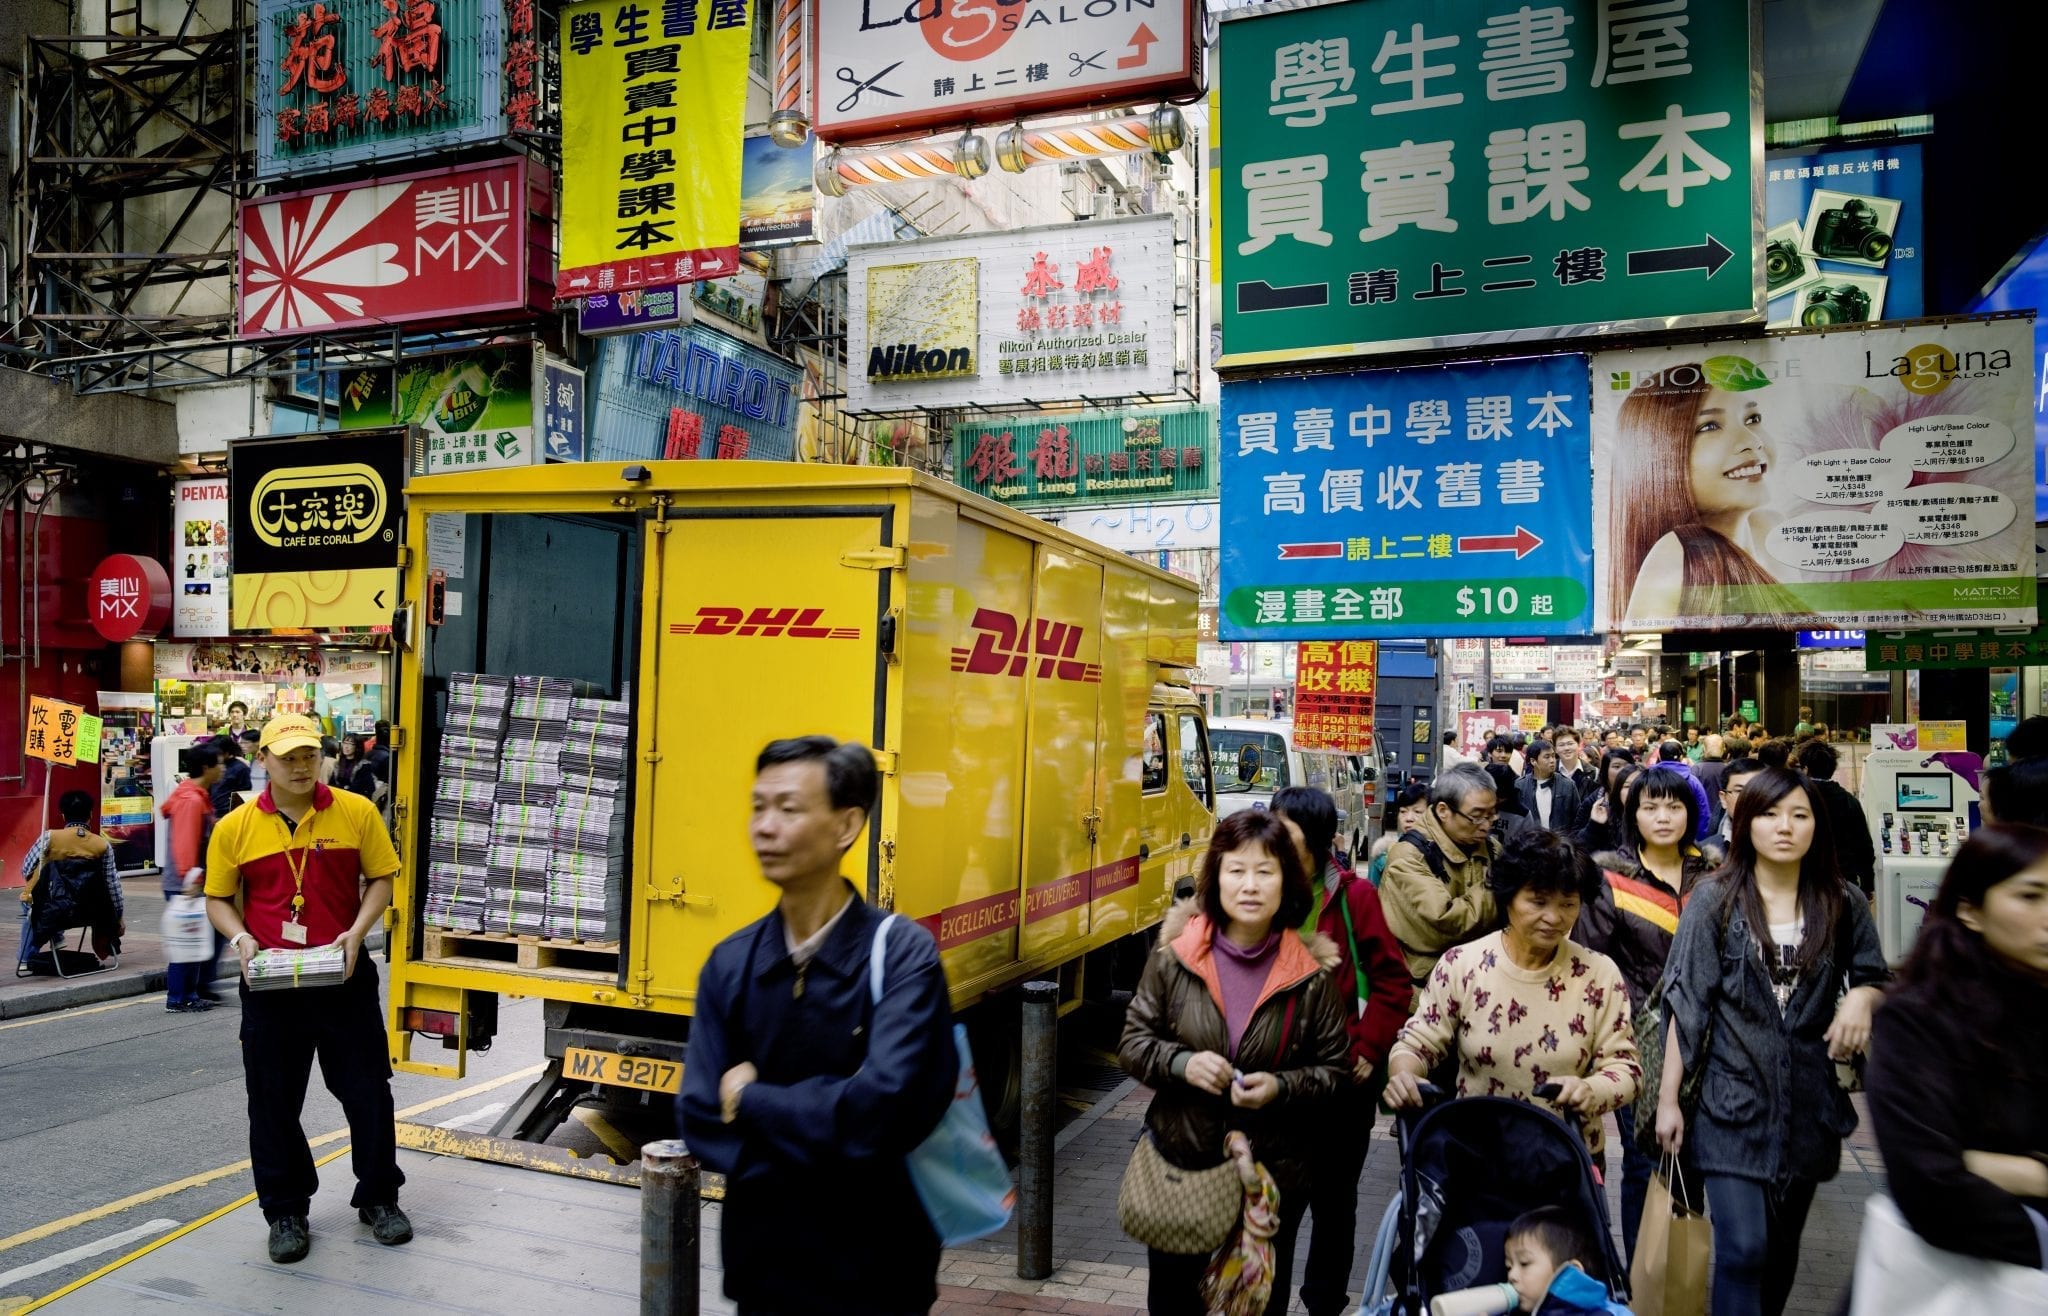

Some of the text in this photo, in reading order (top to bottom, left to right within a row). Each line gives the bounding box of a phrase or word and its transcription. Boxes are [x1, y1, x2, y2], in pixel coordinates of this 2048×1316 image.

[570, 0, 747, 55] 學生書屋
[1001, 0, 1155, 32] SALON
[1269, 0, 1693, 127] 學生書屋
[933, 63, 1050, 97] 請上二樓
[615, 44, 682, 250] 買賣中學課本
[1237, 104, 1732, 256] 買賣課本
[415, 180, 509, 230] 美心
[415, 224, 508, 276] MX
[597, 257, 694, 290] 請上二樓
[1348, 247, 1607, 306] 請上二樓
[649, 303, 675, 317] ZONE
[999, 331, 1147, 353] Nikon Authorized Dealer
[867, 344, 971, 377] Nikon
[1865, 349, 2012, 389] Laguna
[637, 330, 792, 429] TAMRON
[1943, 371, 2000, 381] SALON
[454, 401, 479, 421] BITE
[1237, 391, 1573, 456] 買賣中學課本
[429, 434, 487, 450] 飲品、上網、漫畫
[1124, 435, 1162, 447] HOURS
[1136, 426, 1158, 438] 24
[1908, 425, 1925, 433] High
[1966, 422, 1990, 430] Colour
[443, 450, 487, 466] 通宵營業
[964, 424, 1079, 484] 銀龍
[1807, 459, 1822, 467] High
[1823, 459, 1840, 467] Light
[988, 474, 1174, 499] Ngan Lung Restaurant
[1263, 459, 1545, 515] 高價收舊書
[283, 534, 353, 547] CAFÉ DE CORAL
[1346, 534, 1454, 561] 請上二樓
[1792, 535, 1808, 543] High
[1836, 533, 1854, 541] Base
[100, 577, 139, 597] 美心
[1953, 586, 2020, 596] MATRIX
[100, 598, 139, 619] MX
[1254, 586, 1404, 624] 漫畫全部
[1455, 585, 1519, 617] $10
[1530, 594, 1554, 616] 起
[692, 607, 833, 639] DHL
[965, 607, 1087, 682] DHL
[1301, 641, 1374, 666] 高價
[1456, 650, 1485, 658] VIRGINI
[1879, 641, 2027, 663] 買賣中學課本
[1298, 667, 1372, 692] 收機
[29, 705, 49, 752] 收購
[53, 709, 77, 758] 電話
[1322, 716, 1345, 725] PDA
[1322, 724, 1345, 733] PSP
[79, 717, 98, 758] 電話
[1321, 732, 1345, 742] MP3
[940, 903, 1006, 942] EXCELLENCE.
[1043, 879, 1081, 907] DELIVERED.
[1095, 864, 1136, 889] www.dhl.com
[572, 1052, 676, 1088] MX 9217
